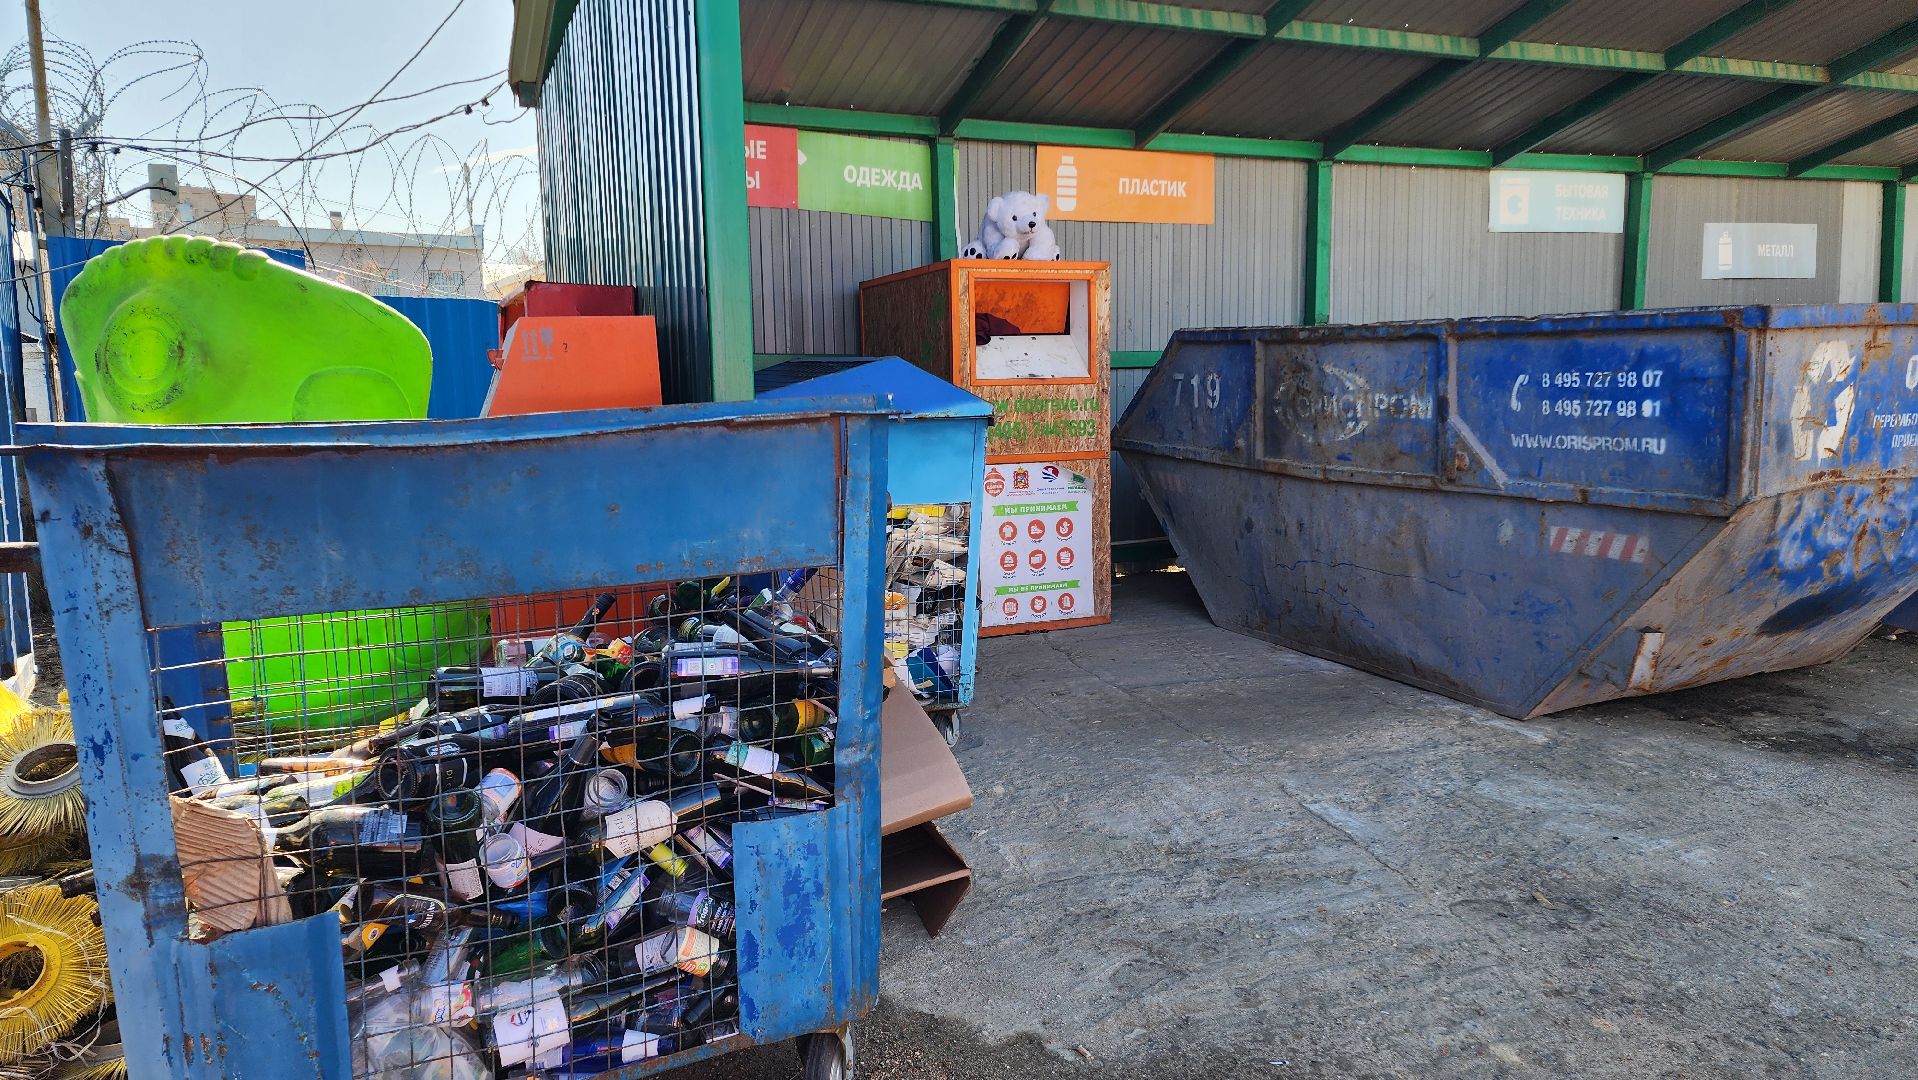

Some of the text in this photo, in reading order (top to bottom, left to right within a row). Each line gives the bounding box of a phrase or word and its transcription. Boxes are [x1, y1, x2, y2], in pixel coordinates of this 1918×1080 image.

[843, 164, 923, 193] ОДЕЖДА
[1118, 177, 1188, 198] ПЛАСТИК
[1555, 183, 1609, 199] БЫТОВАЯ
[1555, 206, 1607, 222] ТЕХНИКА
[1757, 244, 1795, 257] МЕТАЛЛ
[1542, 368, 1663, 388] 8 495 727 98 07
[1172, 371, 1221, 410] 719
[1541, 399, 1550, 415] 8
[1554, 398, 1581, 416] 495
[1585, 400, 1612, 416] 727
[1616, 399, 1637, 417] 98
[1511, 433, 1666, 454] WWW.ORISPROM.RU
